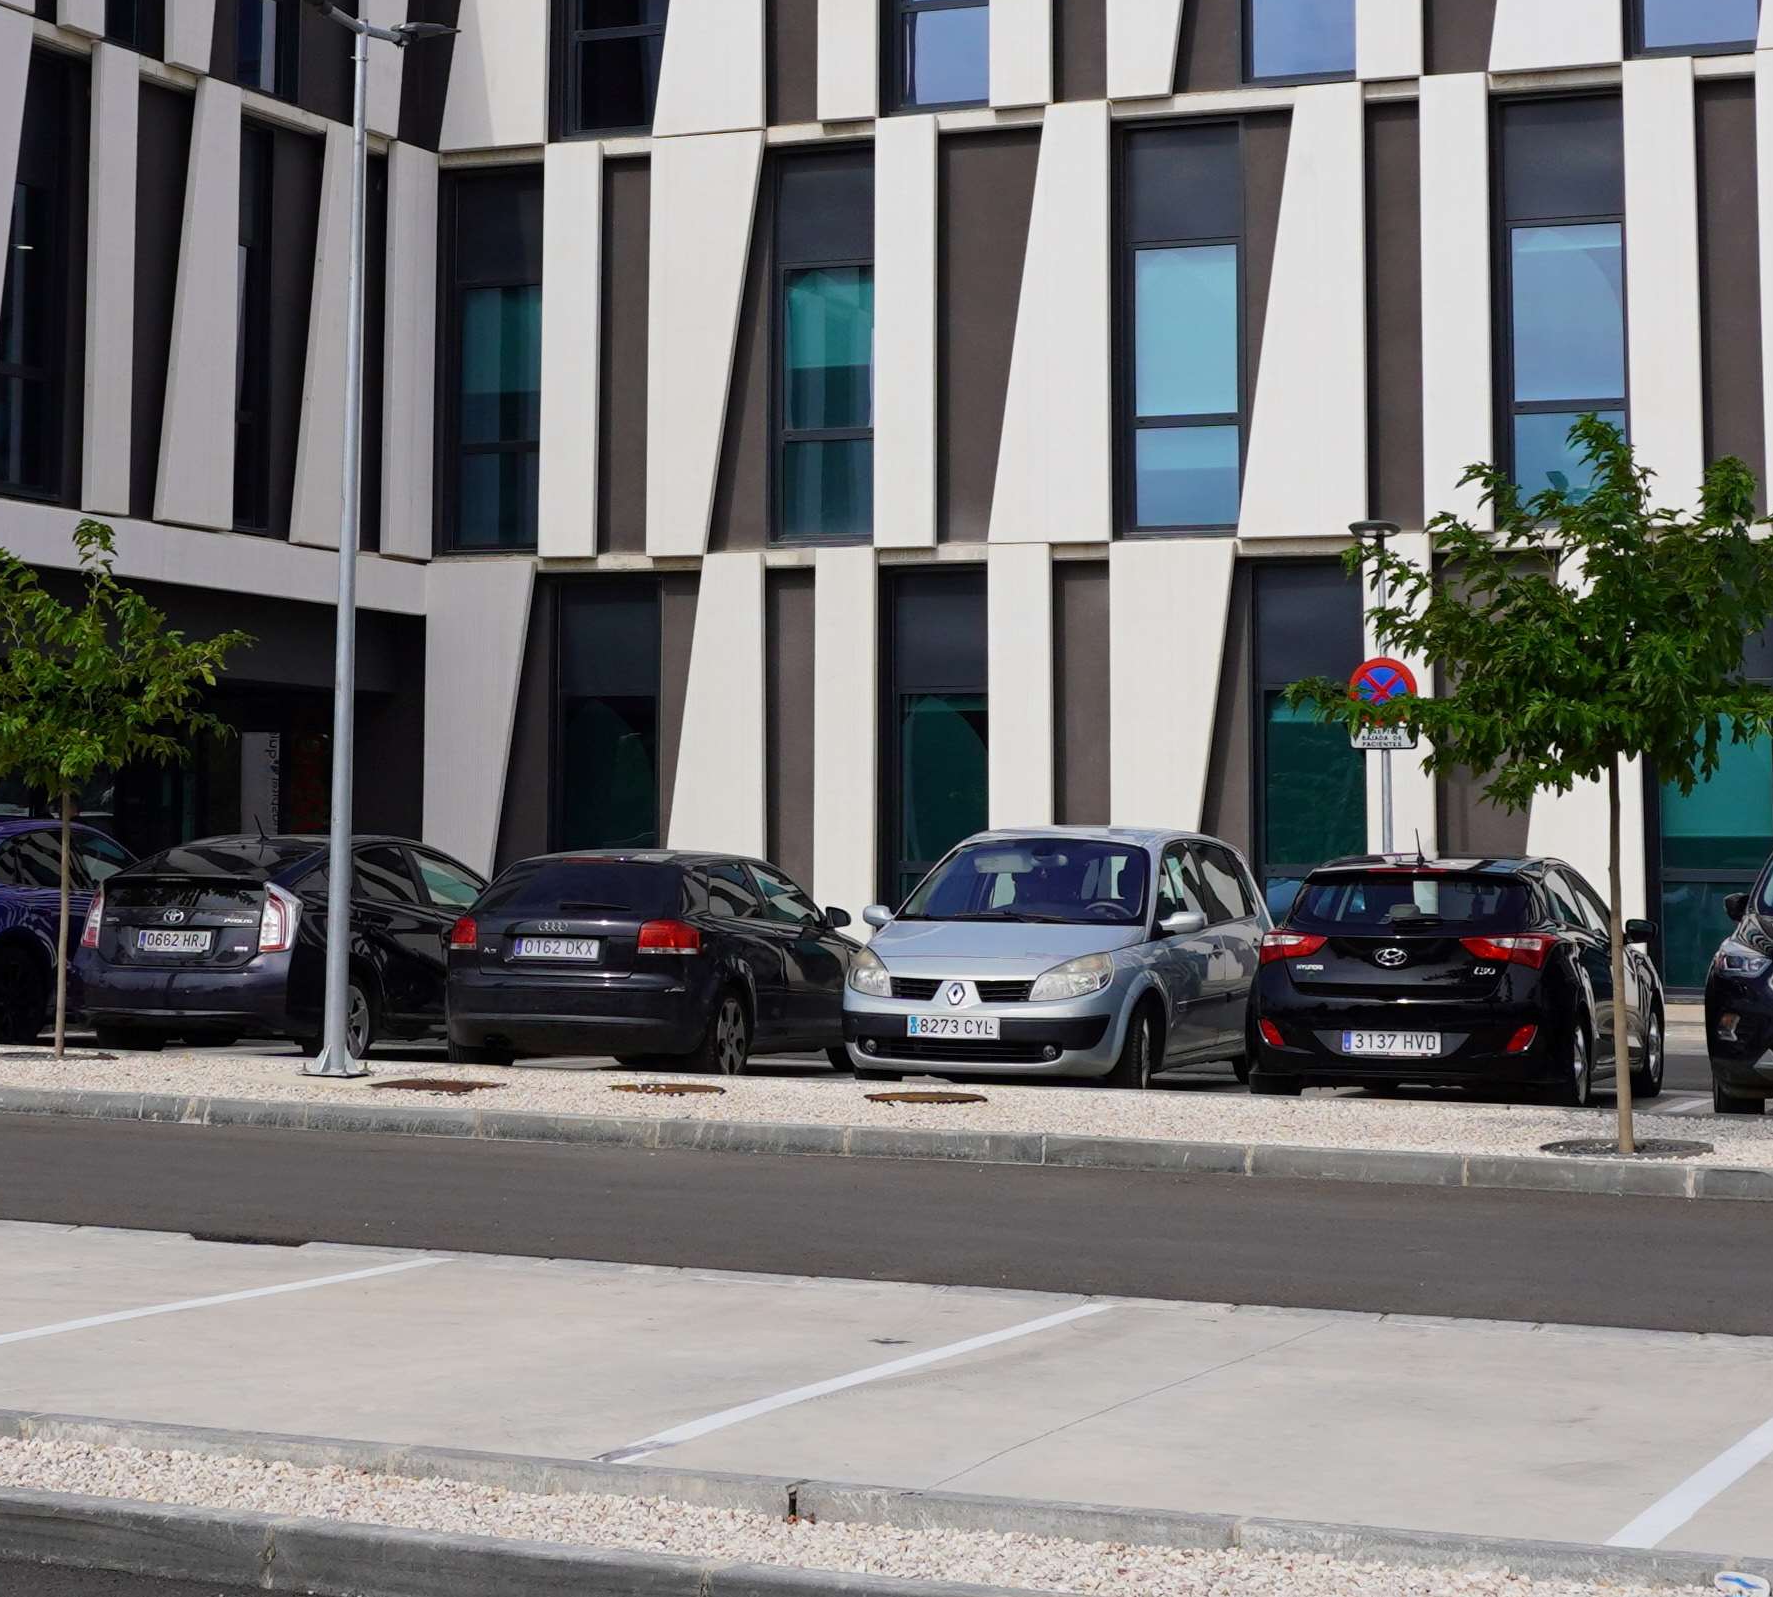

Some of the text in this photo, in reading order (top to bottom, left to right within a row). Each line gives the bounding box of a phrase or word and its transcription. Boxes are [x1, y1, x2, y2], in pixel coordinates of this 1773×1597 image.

[147, 933, 207, 947] 0662 HRJ
[525, 940, 593, 956] 0162 DKX
[920, 1019, 993, 1035] 8273 CYL
[1355, 1033, 1436, 1050] 3137 HVD
